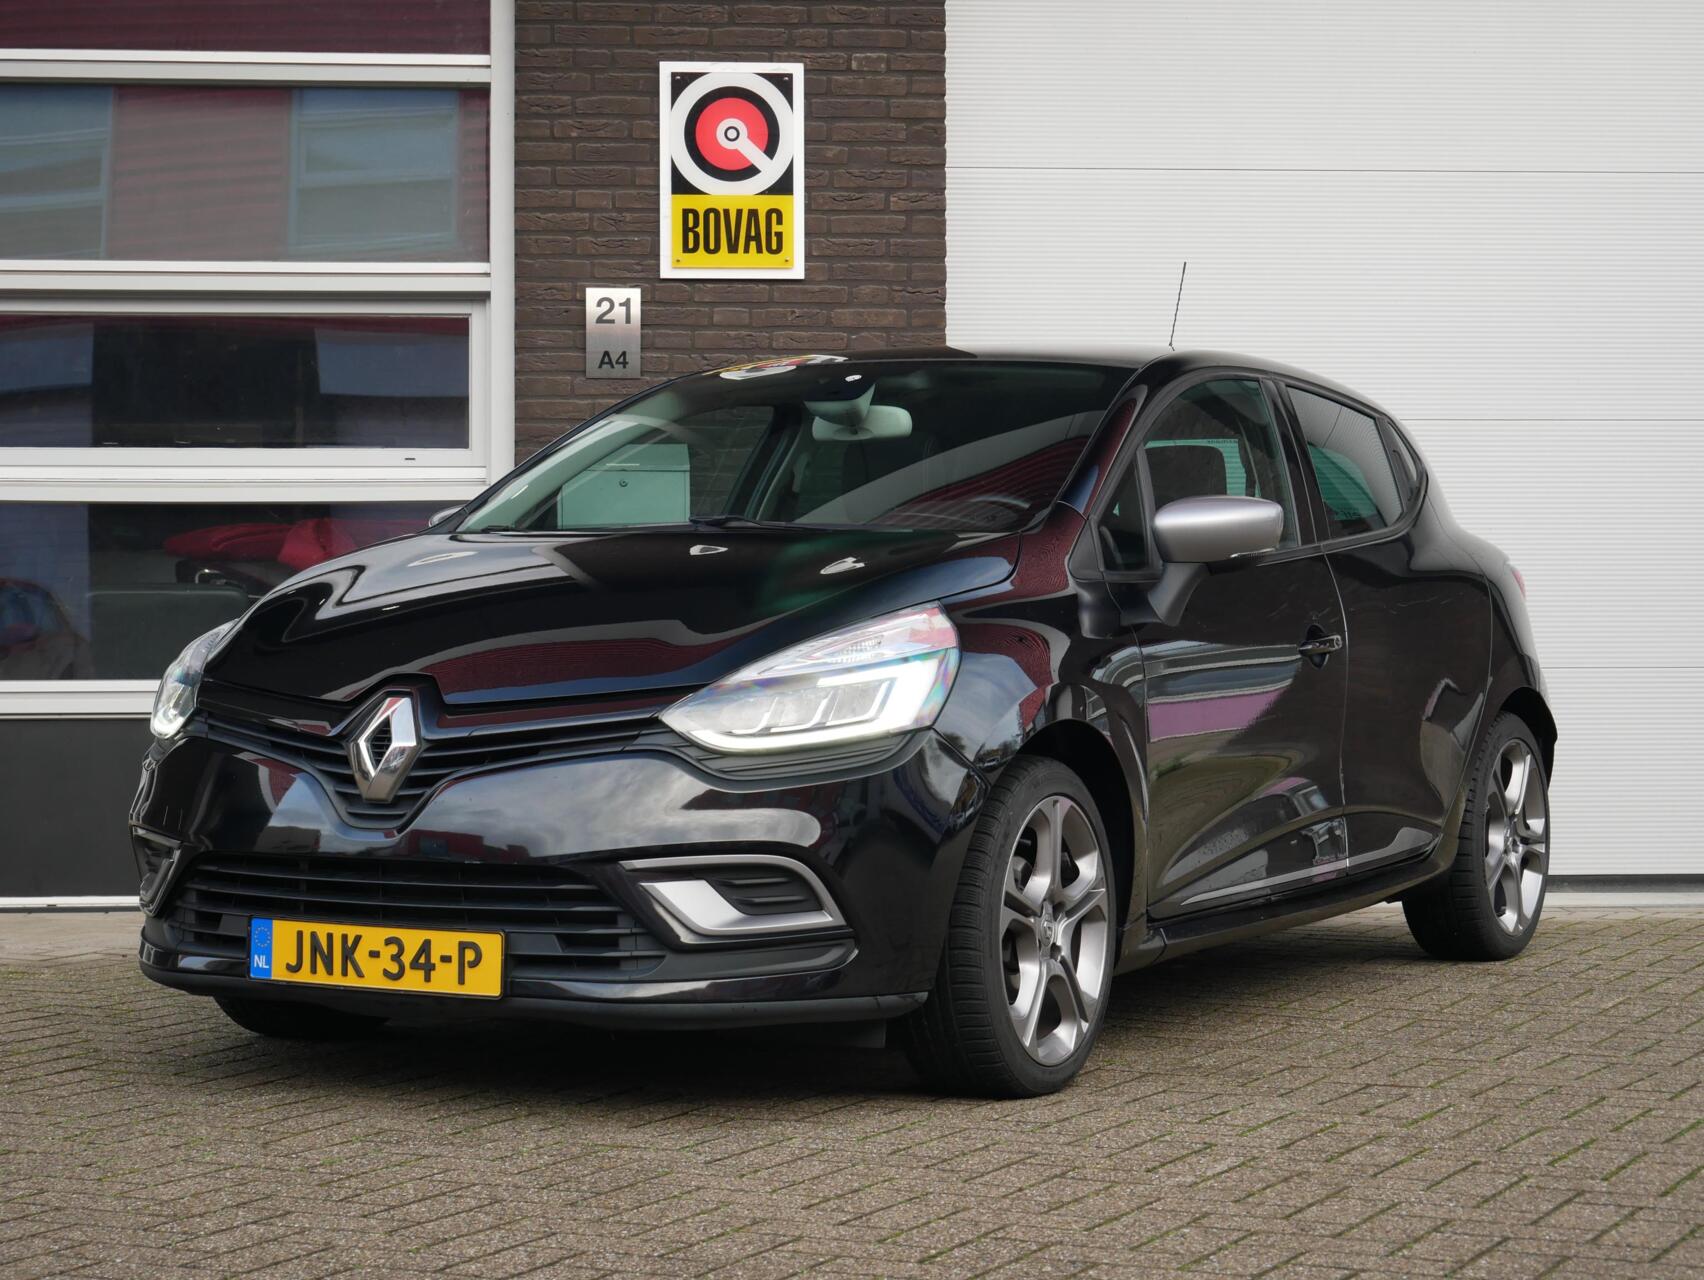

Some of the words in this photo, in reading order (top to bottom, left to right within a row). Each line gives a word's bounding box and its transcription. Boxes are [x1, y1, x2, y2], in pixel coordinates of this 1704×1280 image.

[681, 207, 784, 255] BOVAG
[595, 296, 632, 325] 21
[597, 350, 629, 369] A4
[254, 954, 270, 969] NL
[285, 929, 483, 985] JNK-34-P
